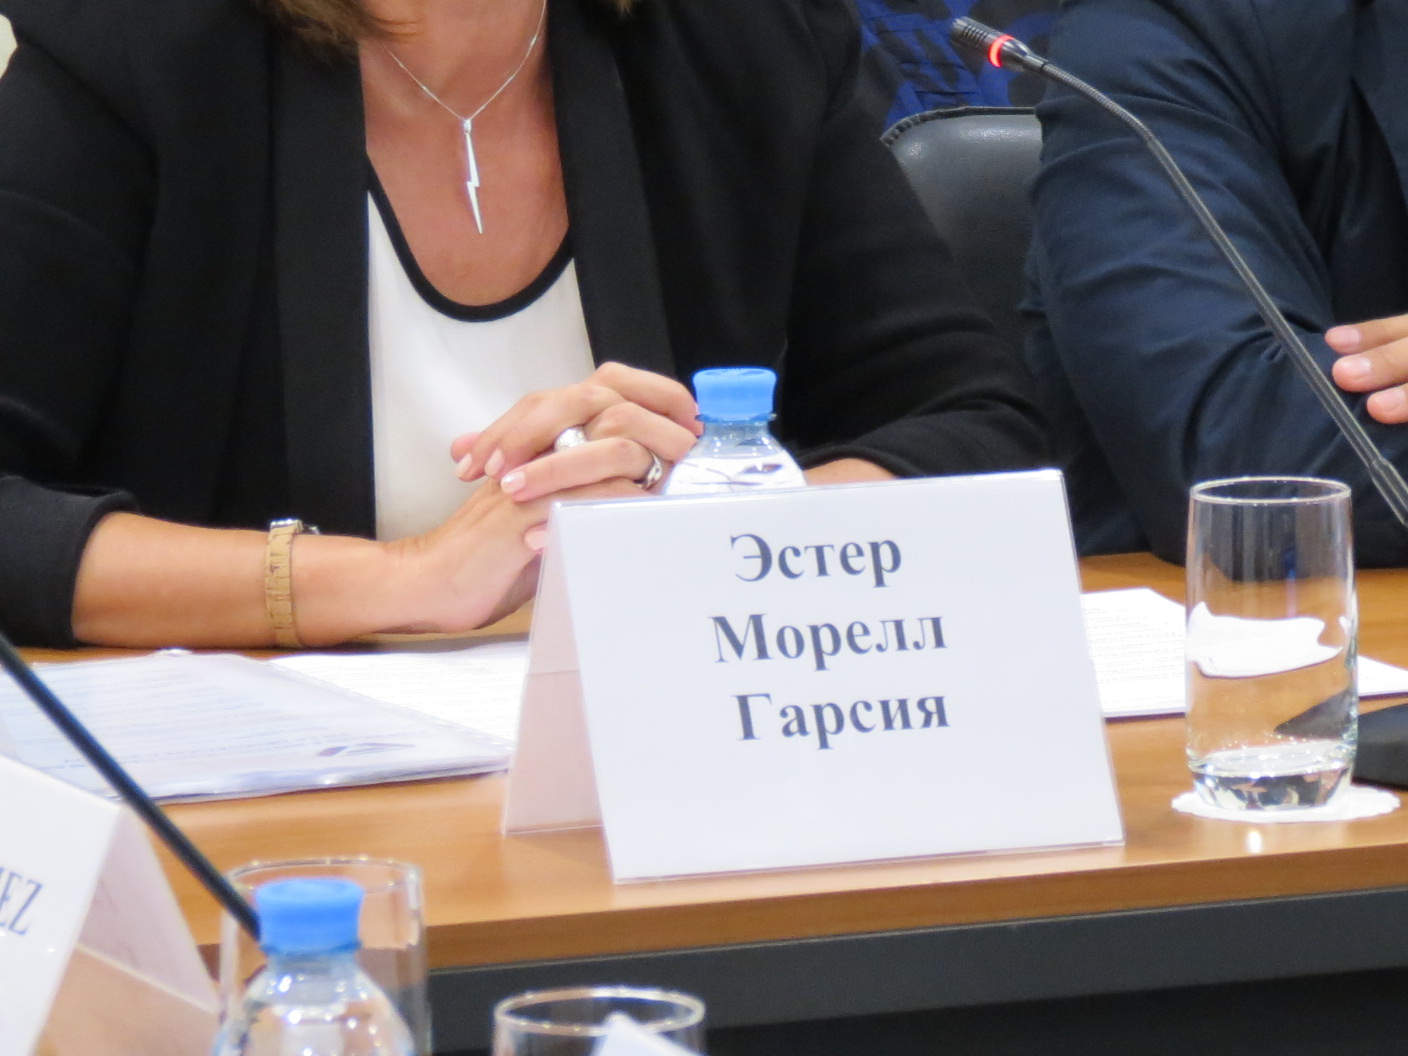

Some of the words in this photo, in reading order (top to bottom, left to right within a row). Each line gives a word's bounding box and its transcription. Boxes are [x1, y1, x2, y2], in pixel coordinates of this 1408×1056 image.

[729, 533, 902, 588] Эстер
[710, 612, 948, 672] Морелл
[734, 693, 951, 750] Гарсия
[0, 866, 44, 936] EZ
